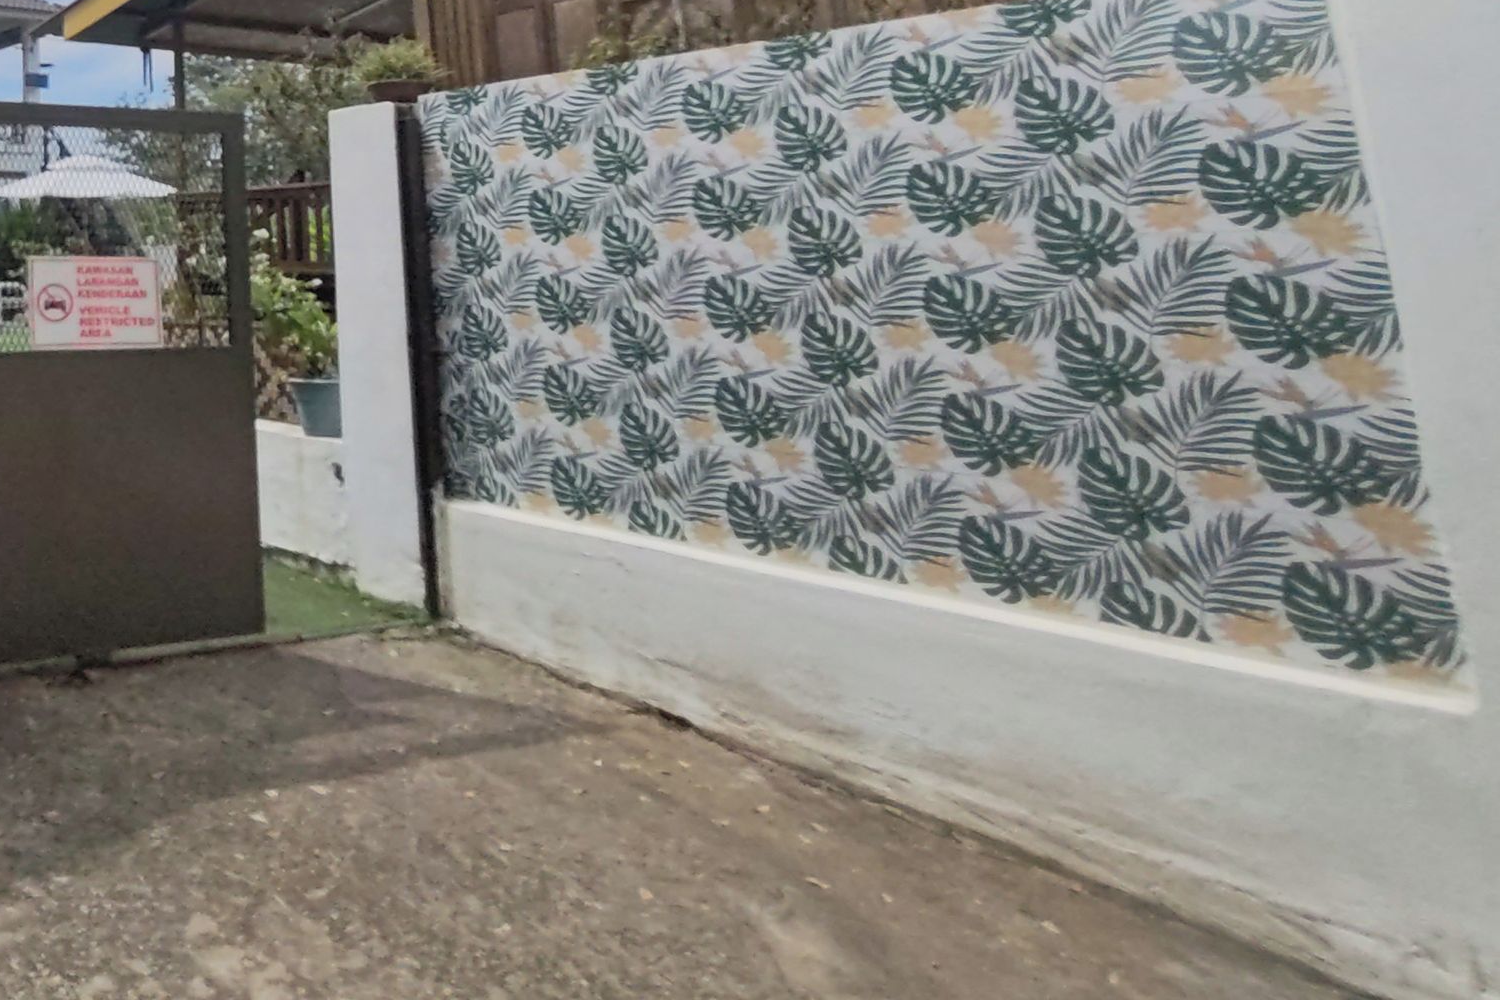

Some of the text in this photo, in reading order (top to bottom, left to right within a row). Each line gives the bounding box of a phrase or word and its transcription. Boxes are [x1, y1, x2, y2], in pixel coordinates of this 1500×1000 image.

[79, 306, 130, 315] VEHICLE
[79, 317, 155, 327] RESTRICTED
[80, 329, 112, 338] AREA
